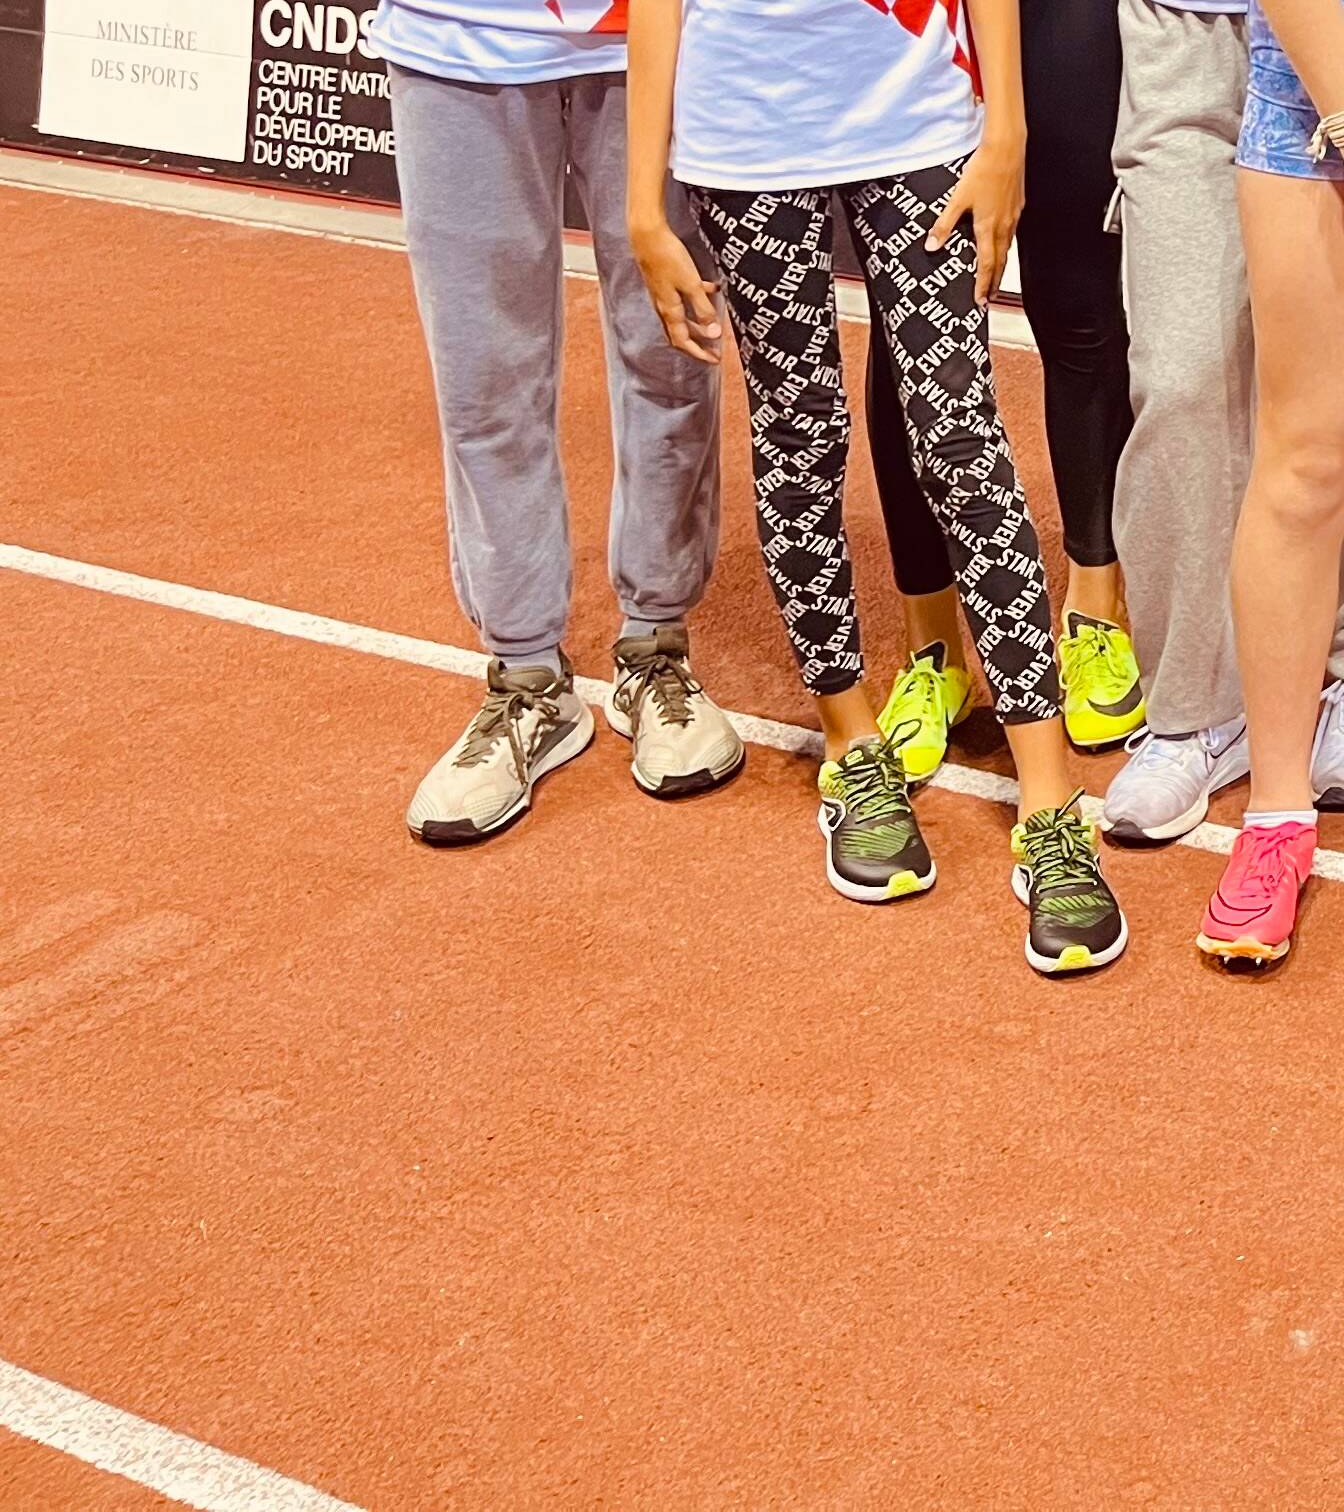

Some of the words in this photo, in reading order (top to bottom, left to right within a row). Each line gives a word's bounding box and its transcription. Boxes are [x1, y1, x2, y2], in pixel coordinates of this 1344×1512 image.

[96, 19, 198, 52] MINISTÈRE
[91, 58, 125, 84] DES
[130, 63, 199, 91] SPORTS
[258, 59, 338, 92] CENTRE
[257, 86, 314, 116] POUR
[317, 94, 343, 120] LE
[253, 140, 282, 167] DU
[285, 144, 354, 176] SPORT
[740, 193, 781, 232] EVER
[886, 184, 926, 220] STAR
[751, 232, 799, 262] STAR
[801, 212, 824, 251] EVER
[884, 221, 926, 256] EVER
[728, 271, 768, 305] STAR
[771, 262, 809, 301] EVER
[885, 258, 918, 296] STAR
[920, 257, 966, 296] EVER
[783, 301, 824, 326] STAR
[919, 297, 960, 334] STAR
[756, 341, 798, 372] STAR
[800, 325, 829, 365] EVER
[891, 334, 915, 374] STAR
[915, 335, 959, 376] EVER
[918, 376, 958, 416] STAR
[753, 433, 788, 466] STAR
[966, 441, 998, 480] EVER
[755, 468, 790, 497] EVER
[792, 495, 833, 531] EVER
[989, 509, 1023, 548] EVER
[763, 534, 794, 563] EVER
[796, 532, 836, 557] STAR
[950, 520, 988, 553] STAR
[804, 557, 842, 595] EVER
[962, 554, 995, 588] EVER
[996, 549, 1037, 579] STAR
[811, 595, 849, 615] STAR
[967, 589, 1002, 623] STAR
[1004, 580, 1042, 620] EVER
[824, 615, 853, 652] EVER
[977, 624, 1006, 657] EVER
[1008, 621, 1048, 651] STAR
[1013, 652, 1052, 690] EVER
